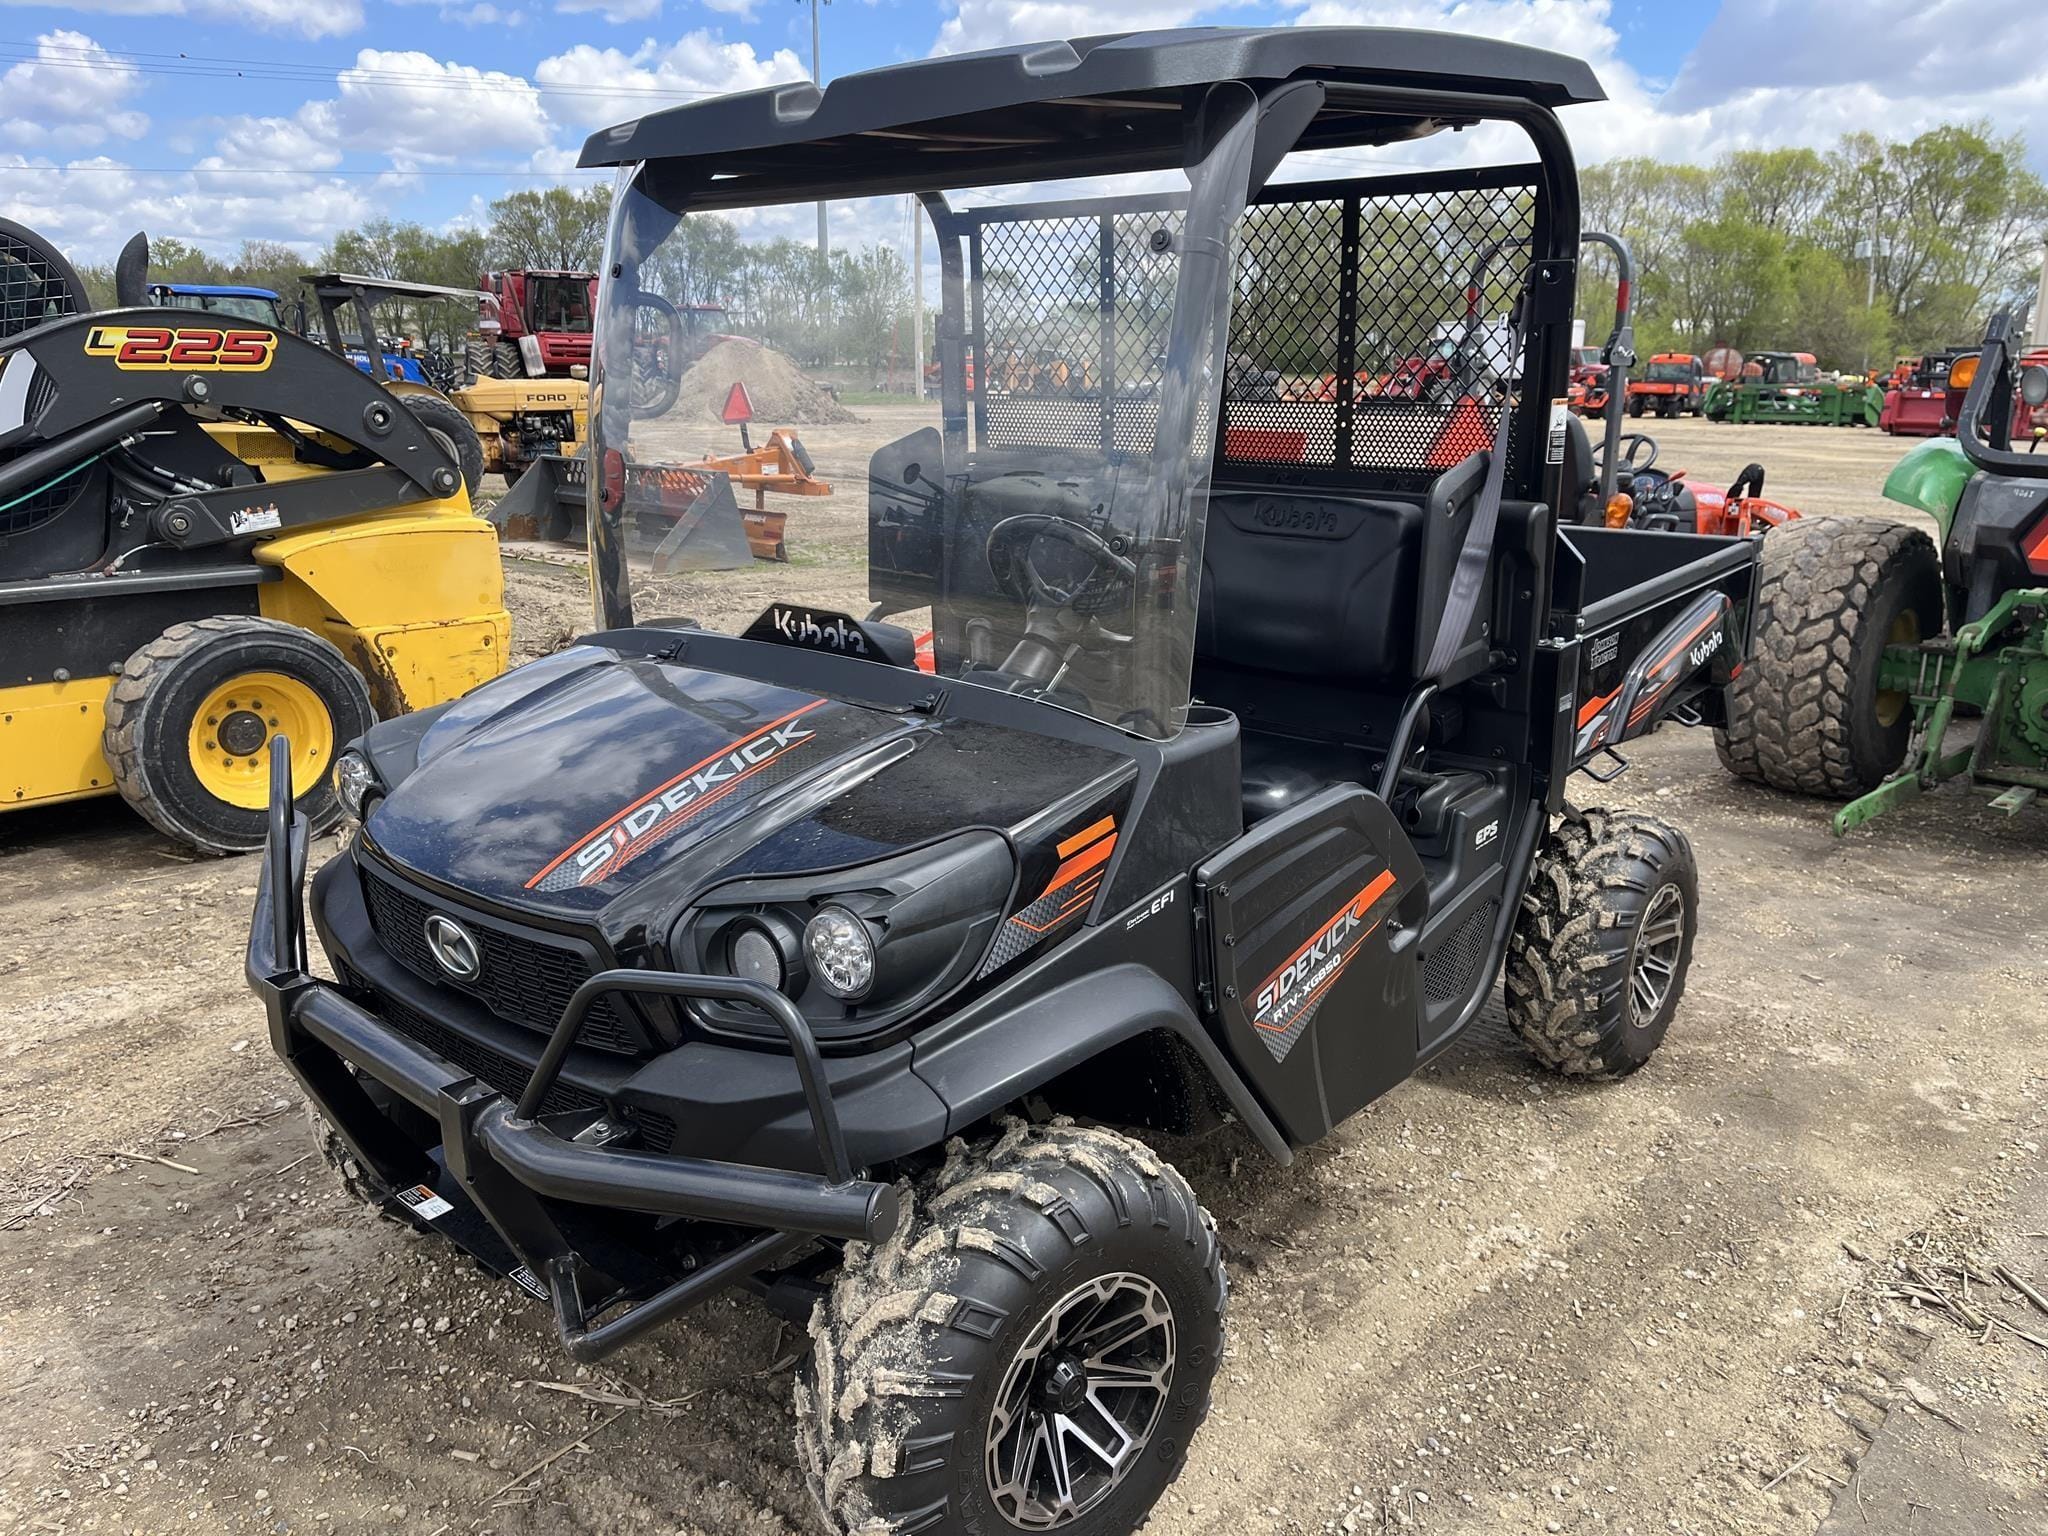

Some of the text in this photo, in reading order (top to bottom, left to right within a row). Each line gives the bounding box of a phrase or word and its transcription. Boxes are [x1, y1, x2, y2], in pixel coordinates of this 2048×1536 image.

[526, 393, 567, 402] FORD
[1254, 500, 1338, 532] Kubota
[773, 608, 868, 654] Kubota
[1690, 631, 1723, 666] Kubota
[576, 718, 816, 882] SIDEKICK
[1475, 820, 1499, 845] EPS
[1151, 889, 1174, 915] EFI
[1253, 900, 1361, 1023] SIDEKICK
[1273, 953, 1341, 1022] RTV-XG850
